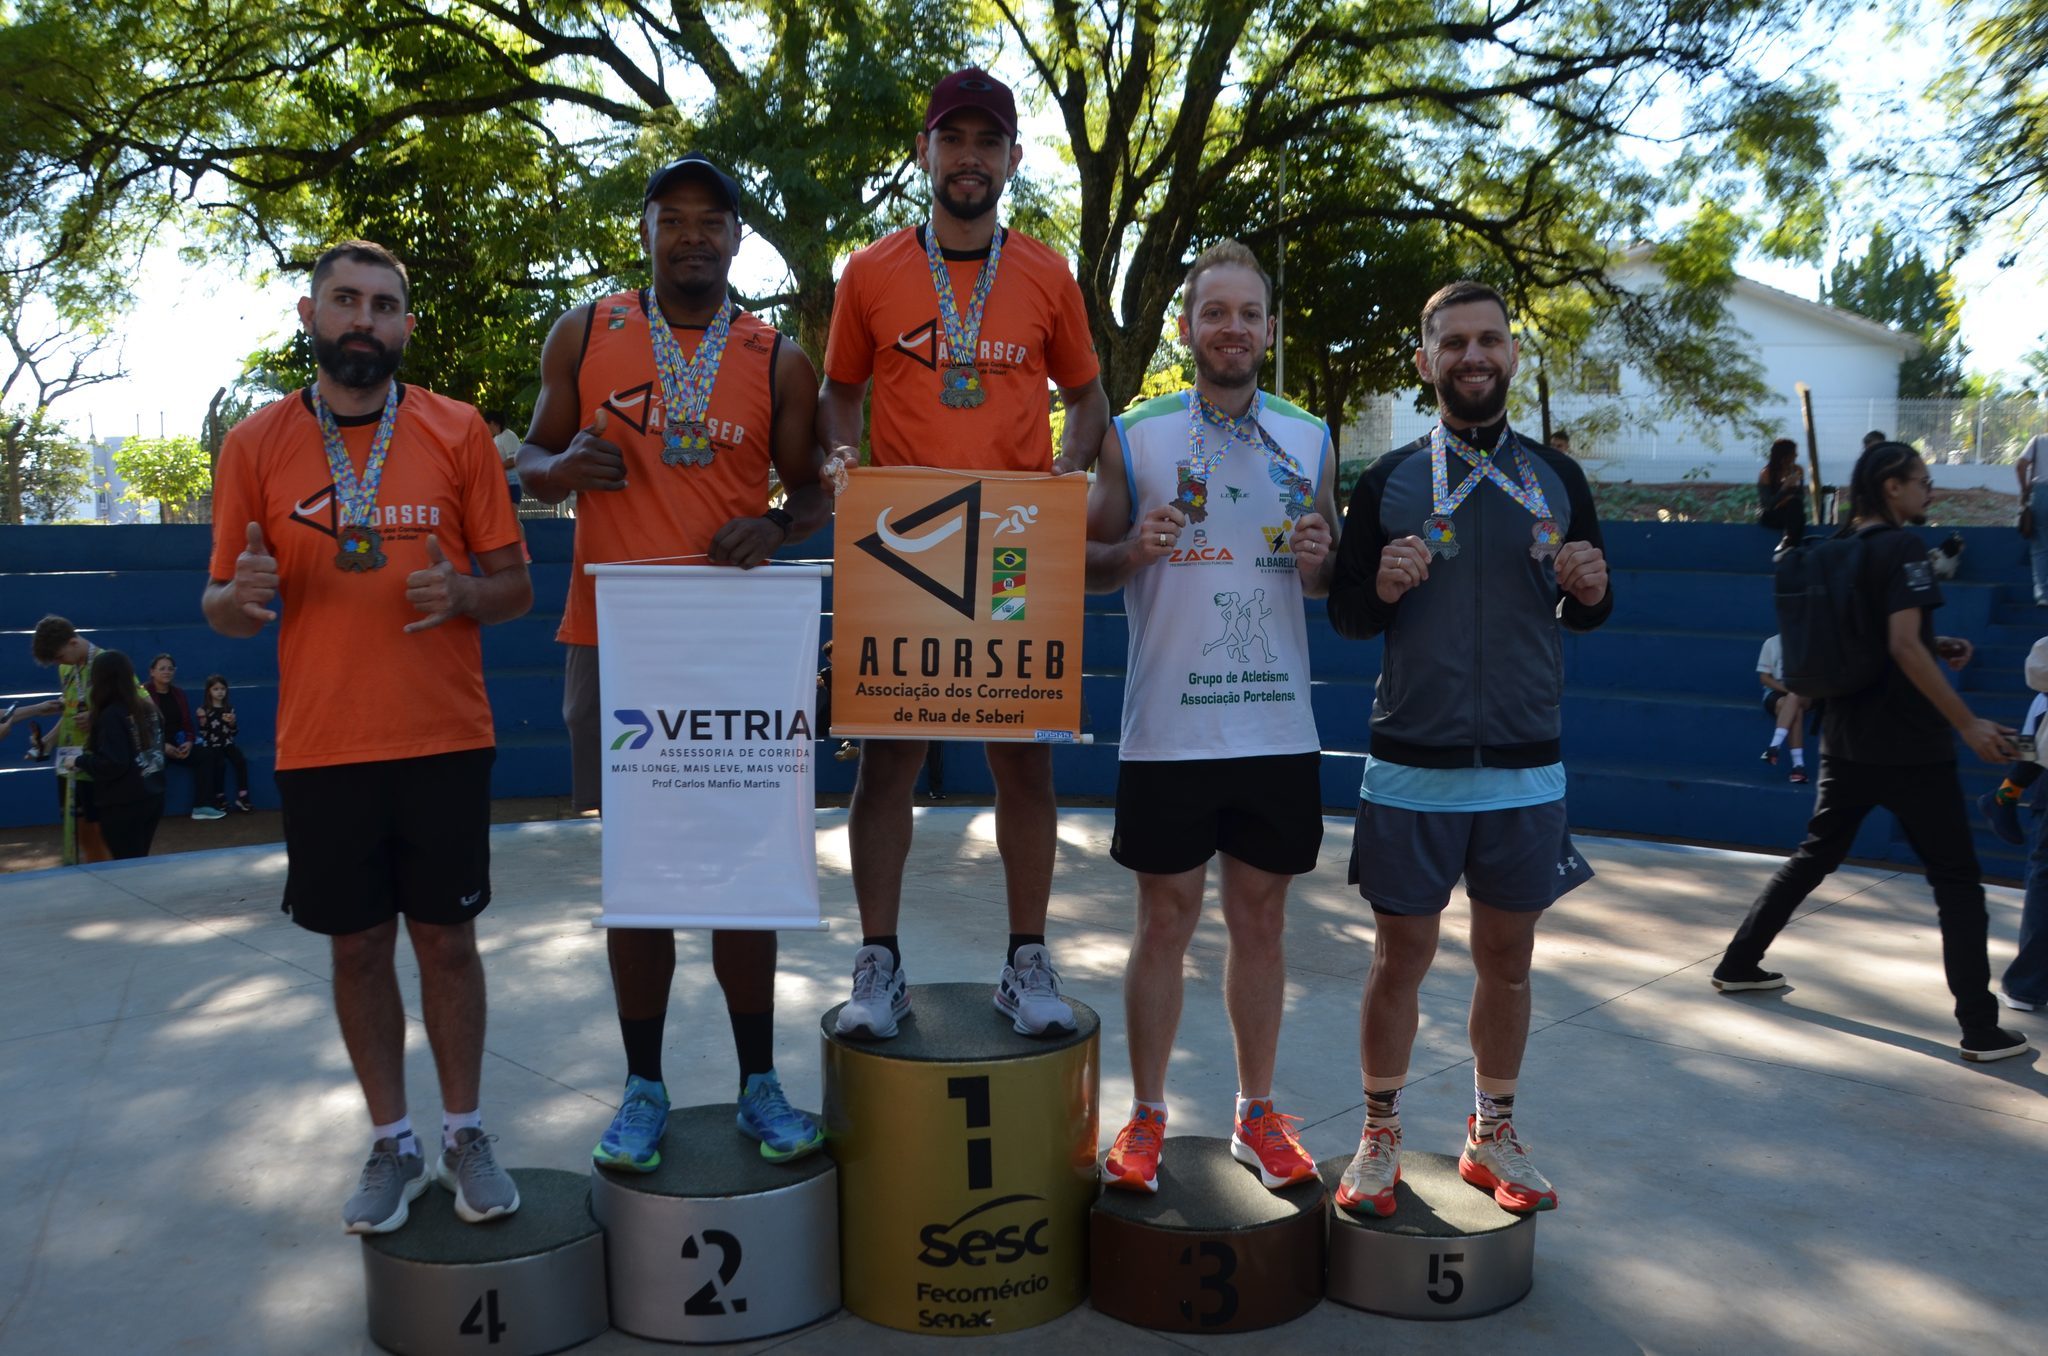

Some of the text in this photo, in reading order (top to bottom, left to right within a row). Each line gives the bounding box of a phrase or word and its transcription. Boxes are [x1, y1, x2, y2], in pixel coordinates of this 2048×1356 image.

[938, 341, 1027, 365] ARSEB
[648, 406, 745, 445] ASEB
[1168, 547, 1234, 562] ZACA
[859, 636, 1065, 680] ACORSEB
[1188, 670, 1289, 687] Grupo de Atletismo
[856, 682, 1063, 701] Associação dos Corredores
[1180, 691, 1241, 706] Associação
[656, 709, 813, 741] VETRIA
[894, 708, 1025, 724] de Rua de Seberi
[660, 748, 810, 758] ASSESSORIA DE CORRIDA
[611, 764, 638, 773] MAIS
[642, 764, 680, 774] LONGE,
[683, 764, 710, 773] MAIS
[714, 764, 743, 774] LEVE,
[747, 764, 774, 773] MAIS
[652, 779, 780, 788] Prof Carlos Manfio Martins
[947, 1075, 993, 1191] 1
[681, 1229, 748, 1317] 2
[1178, 1240, 1239, 1326] 3
[1426, 1252, 1465, 1305] 5
[916, 1273, 1049, 1304] Fecomércio
[458, 1288, 507, 1344] 4
[918, 1309, 993, 1329] Senac
